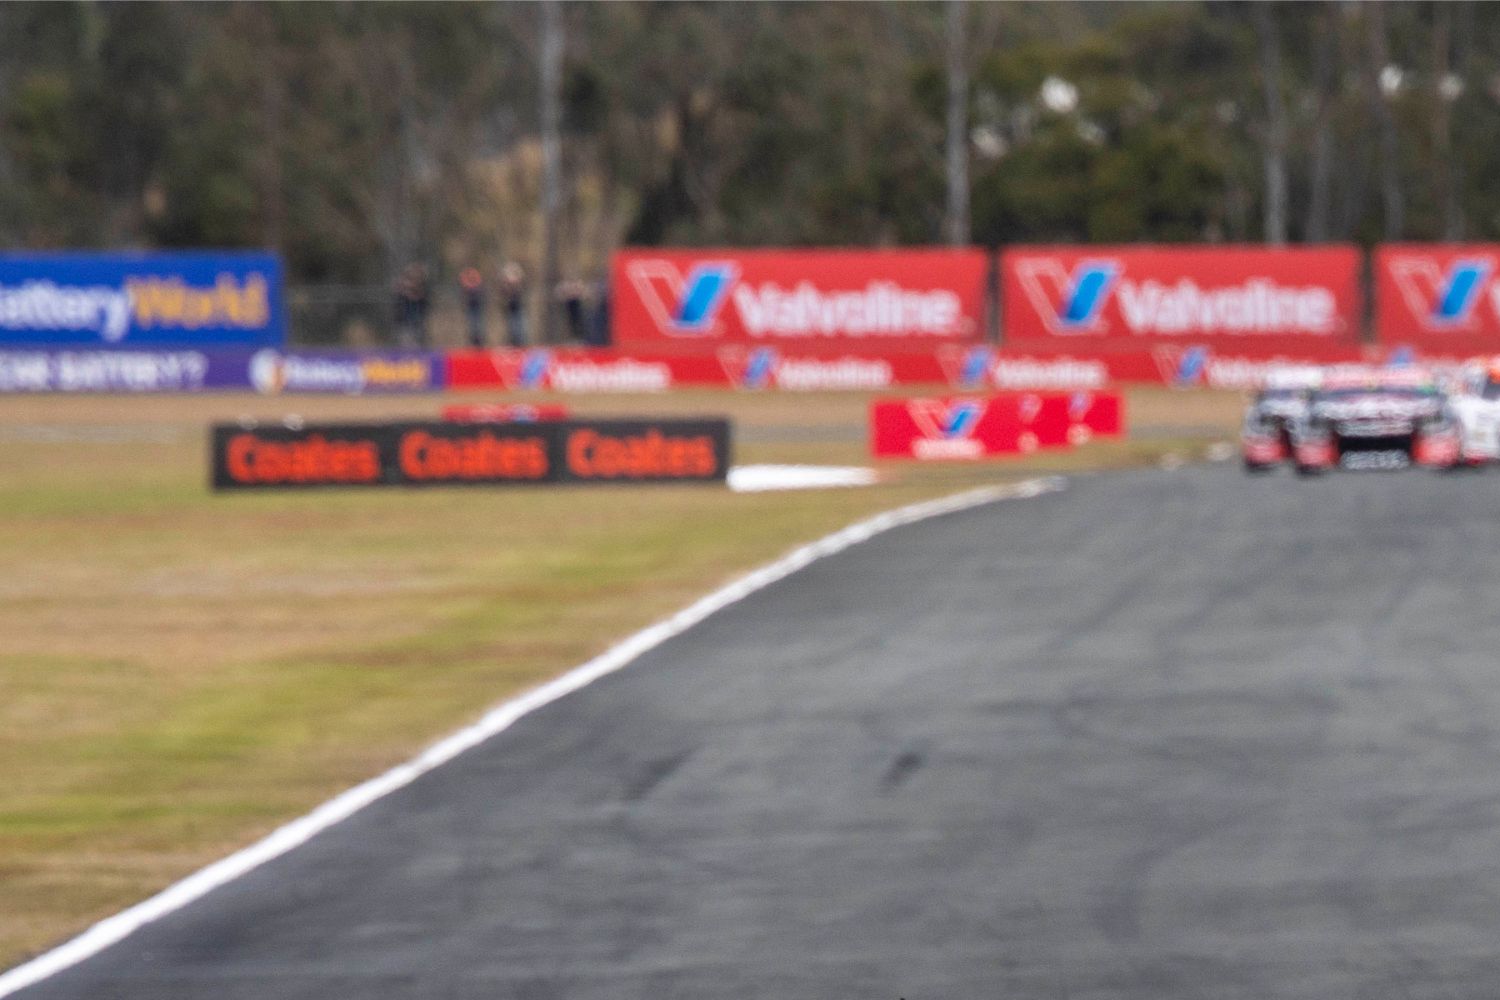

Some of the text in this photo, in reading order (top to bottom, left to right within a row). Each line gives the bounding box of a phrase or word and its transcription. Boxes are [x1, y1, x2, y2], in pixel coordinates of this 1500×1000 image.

[0, 278, 130, 341] attery
[734, 281, 961, 335] Valvoline
[1115, 279, 1337, 334] Valvoline
[227, 431, 717, 482] Coates Coates Coates
